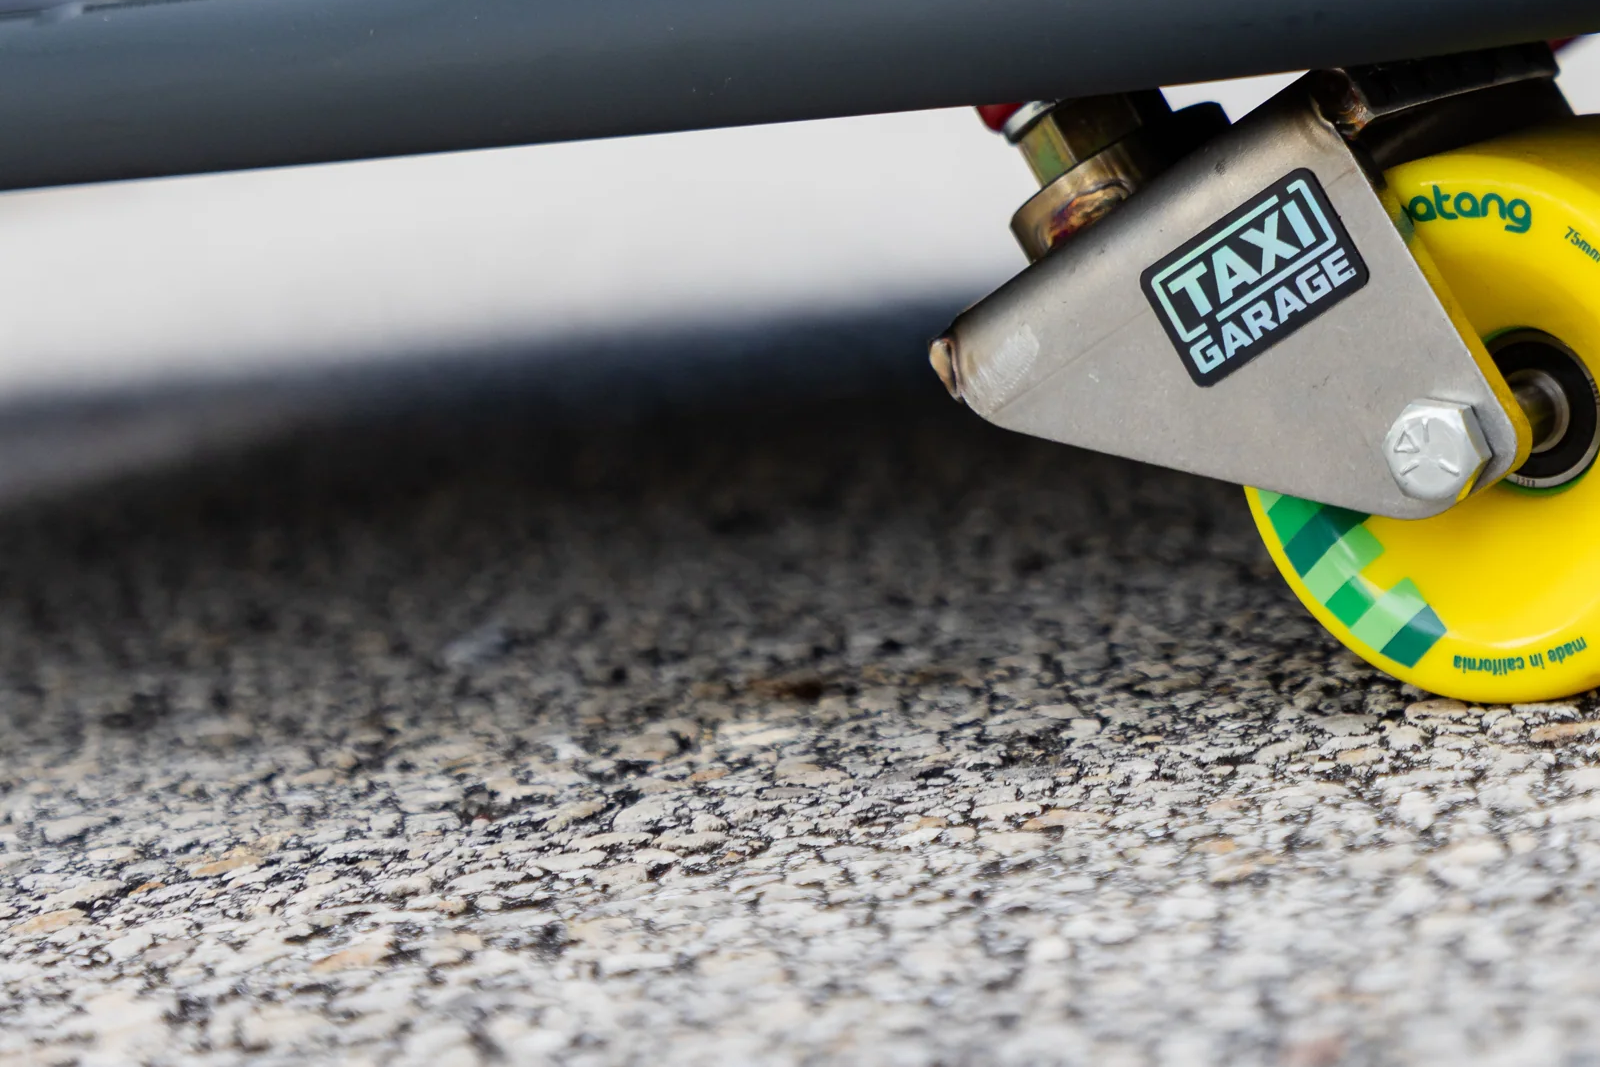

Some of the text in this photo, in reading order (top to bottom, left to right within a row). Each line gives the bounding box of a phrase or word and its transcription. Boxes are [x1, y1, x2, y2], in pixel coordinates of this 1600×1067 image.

[1401, 184, 1532, 234] atang
[1167, 199, 1317, 317] TAXI
[1189, 247, 1356, 374] GARAGE
[1453, 636, 1588, 676] made in california
